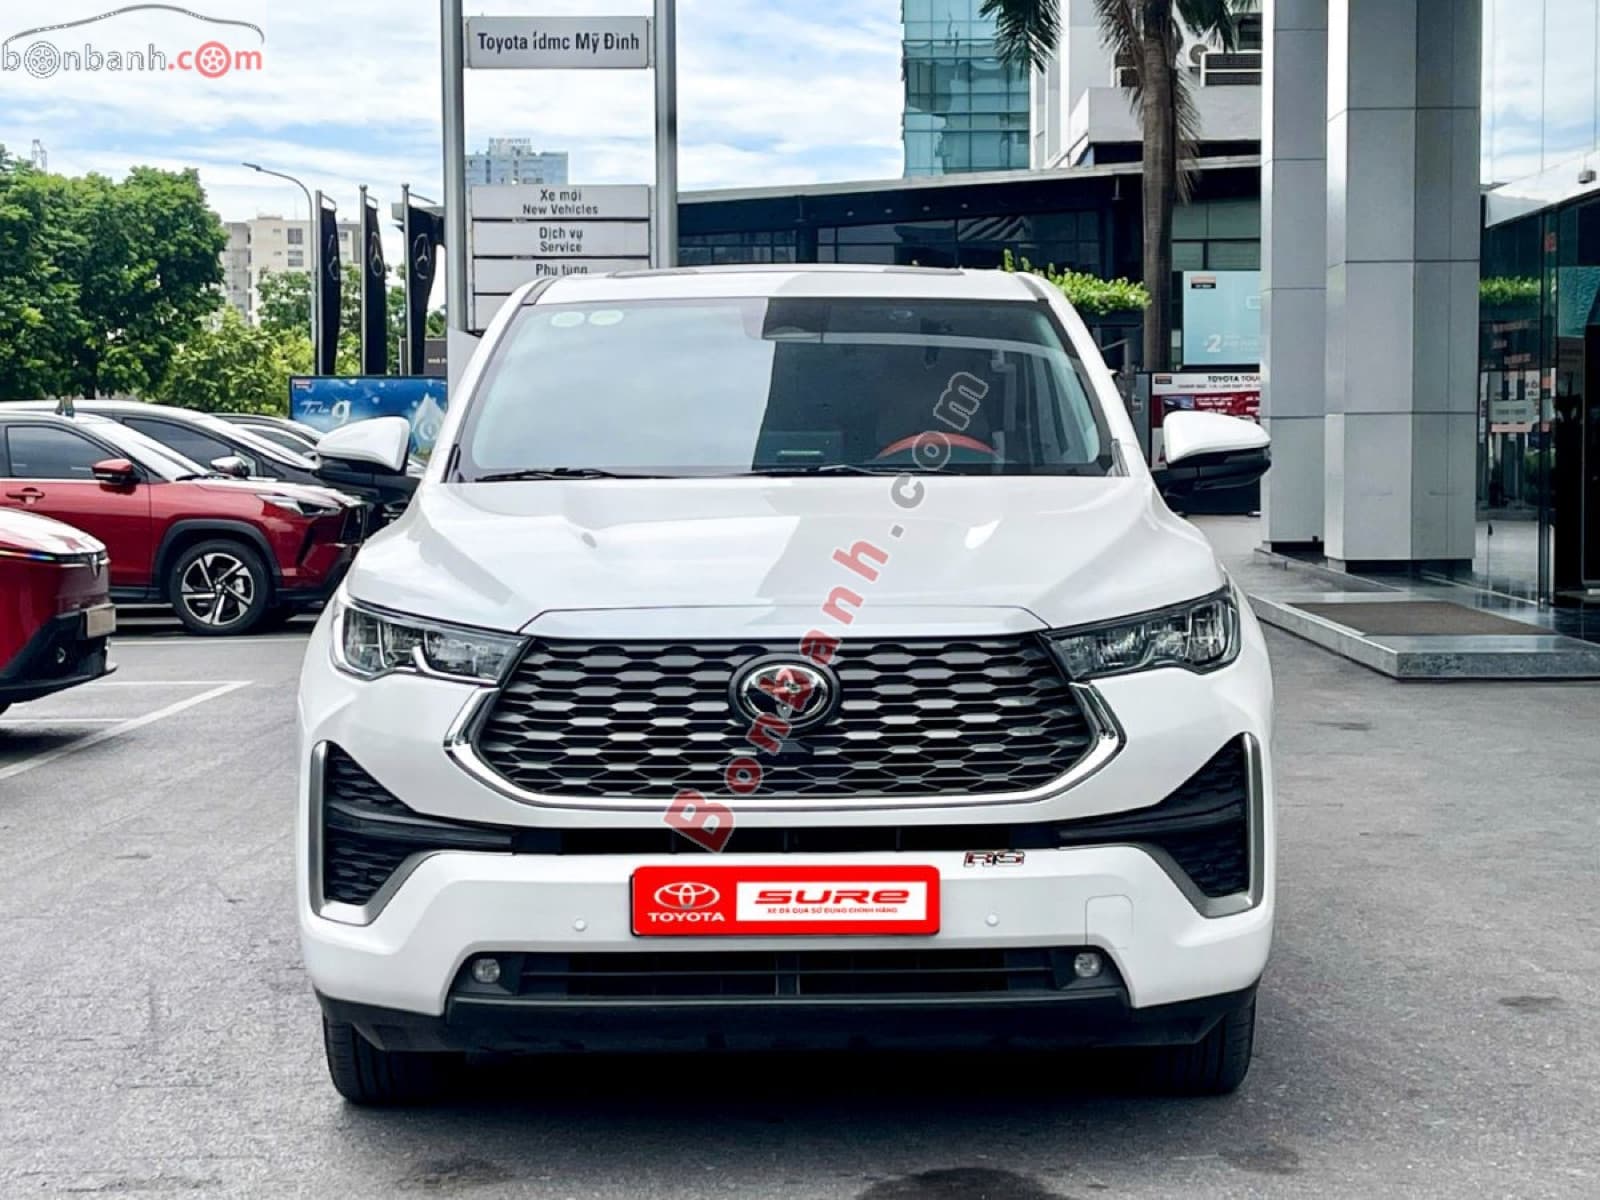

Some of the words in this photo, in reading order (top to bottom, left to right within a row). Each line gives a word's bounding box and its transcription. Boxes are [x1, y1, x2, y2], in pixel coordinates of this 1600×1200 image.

[477, 32, 528, 54] Toyota
[575, 32, 600, 54] Mỹ
[603, 32, 640, 50] Đình
[540, 189, 556, 202] Xe
[522, 204, 547, 215] New
[550, 203, 598, 215] Vehicles
[540, 241, 582, 253] Service
[1207, 375, 1239, 383] TOYOTA
[963, 849, 1025, 867] RS
[647, 912, 726, 922] TOYOTA
